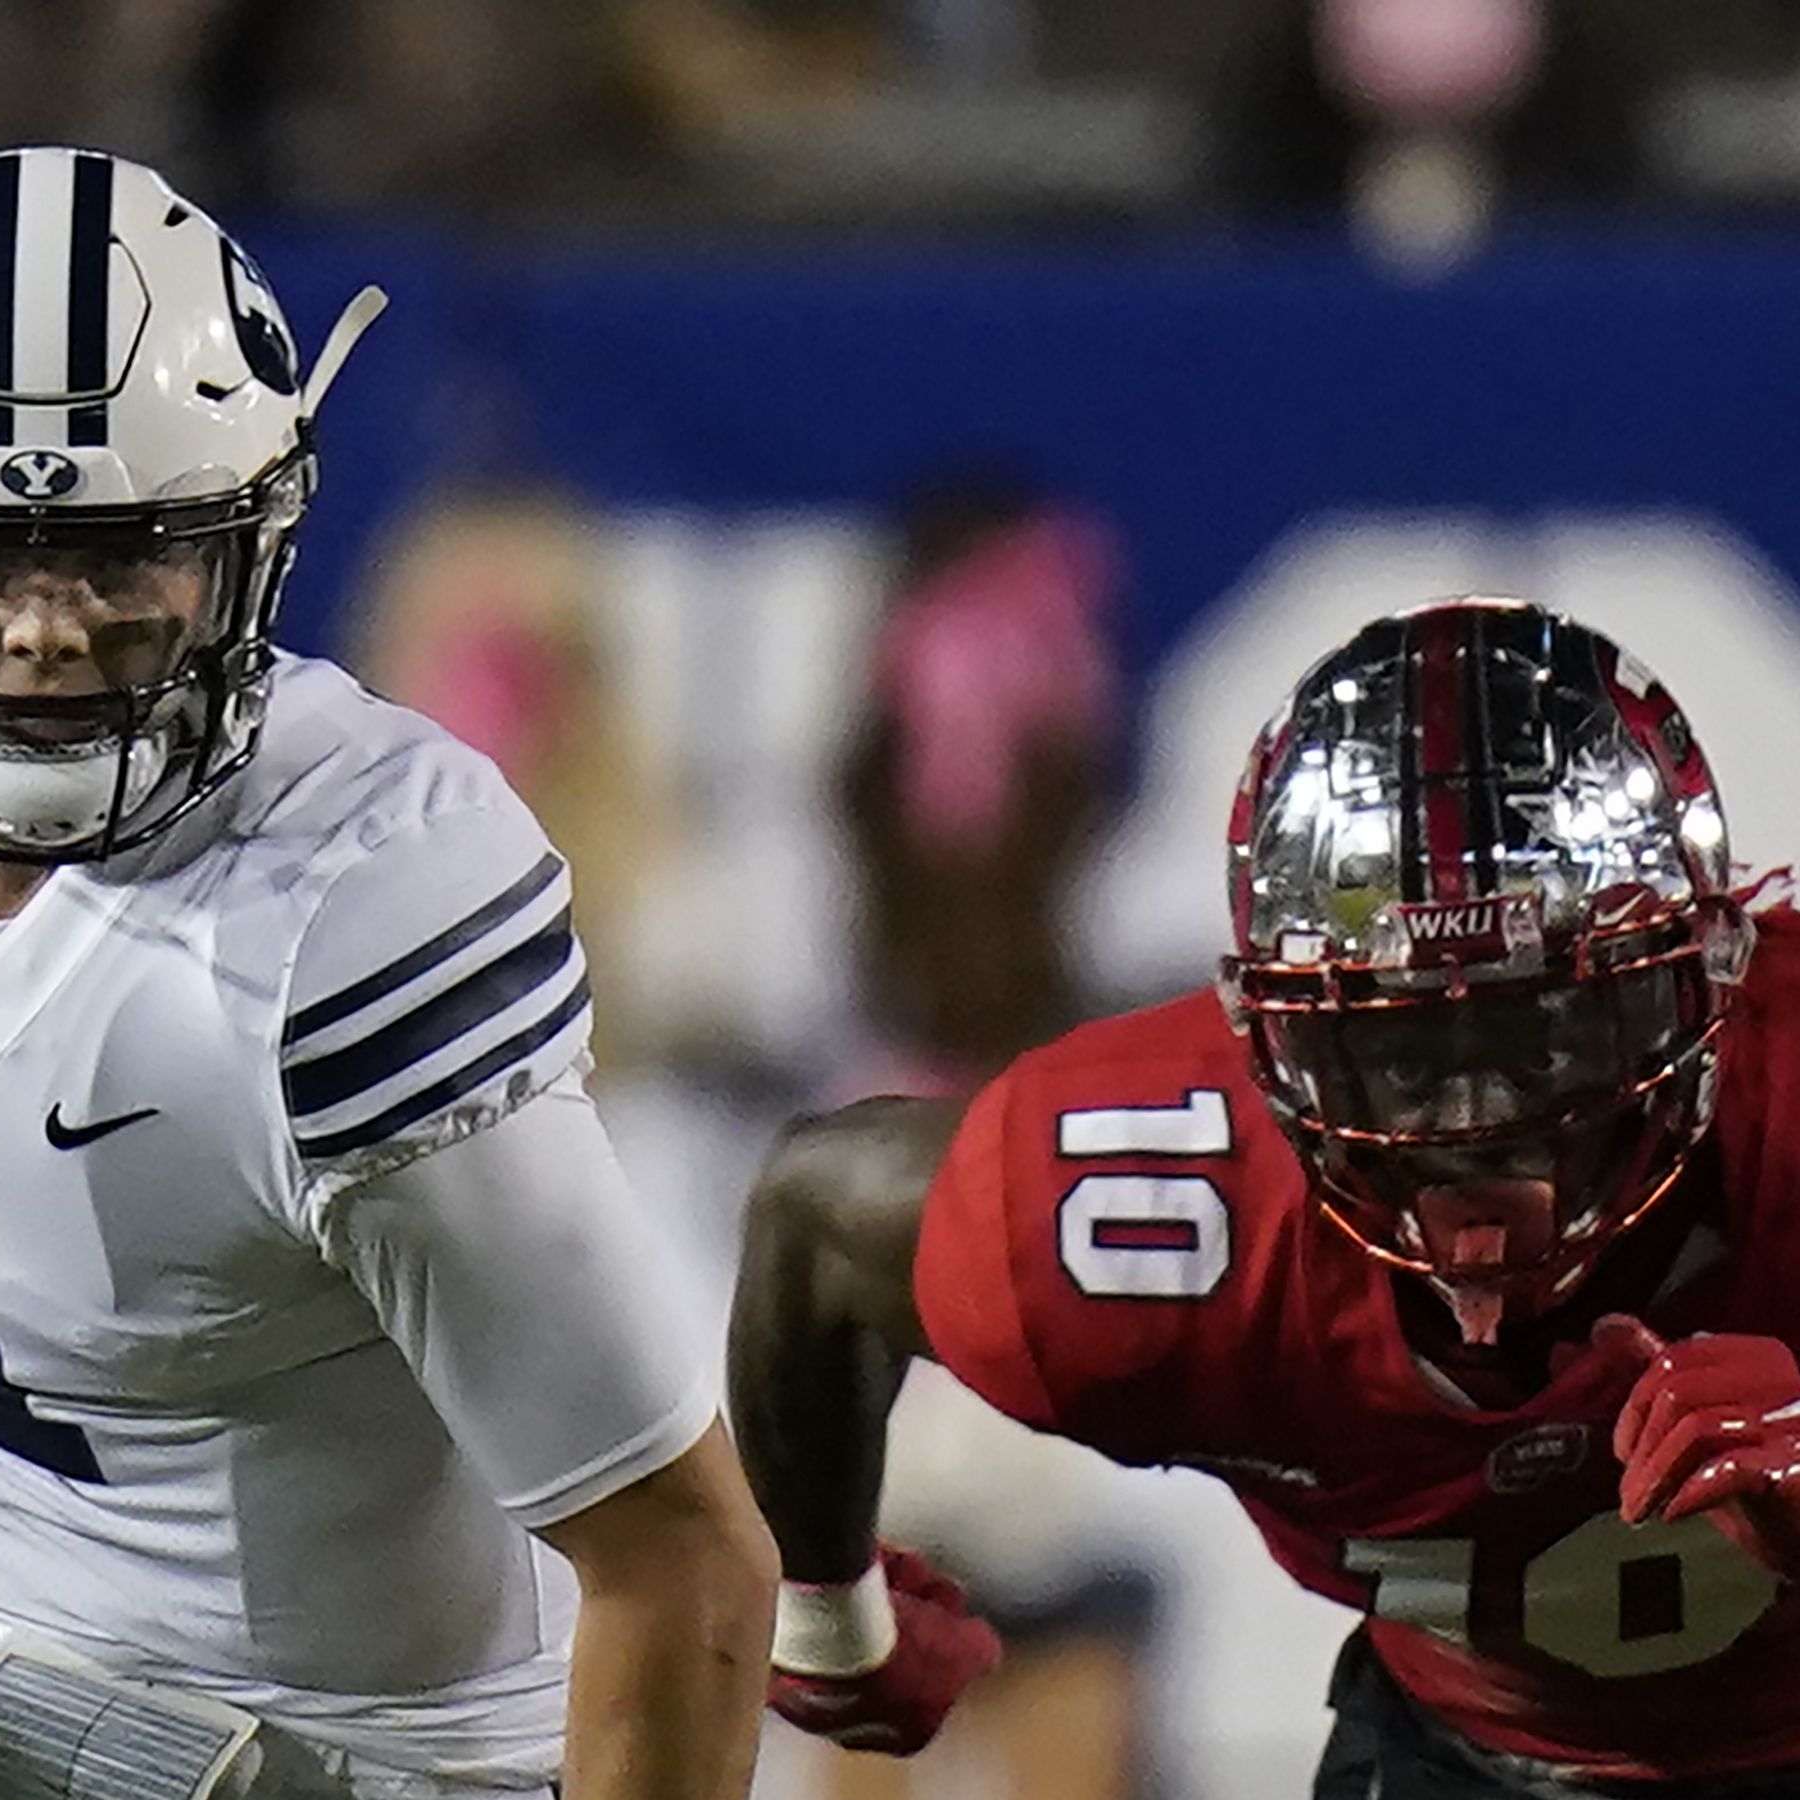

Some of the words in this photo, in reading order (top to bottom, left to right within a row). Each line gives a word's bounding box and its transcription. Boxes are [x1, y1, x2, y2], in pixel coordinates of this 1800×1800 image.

[10, 454, 68, 495] Y
[1408, 904, 1494, 939] WKU
[1057, 1087, 1234, 1299] 10
